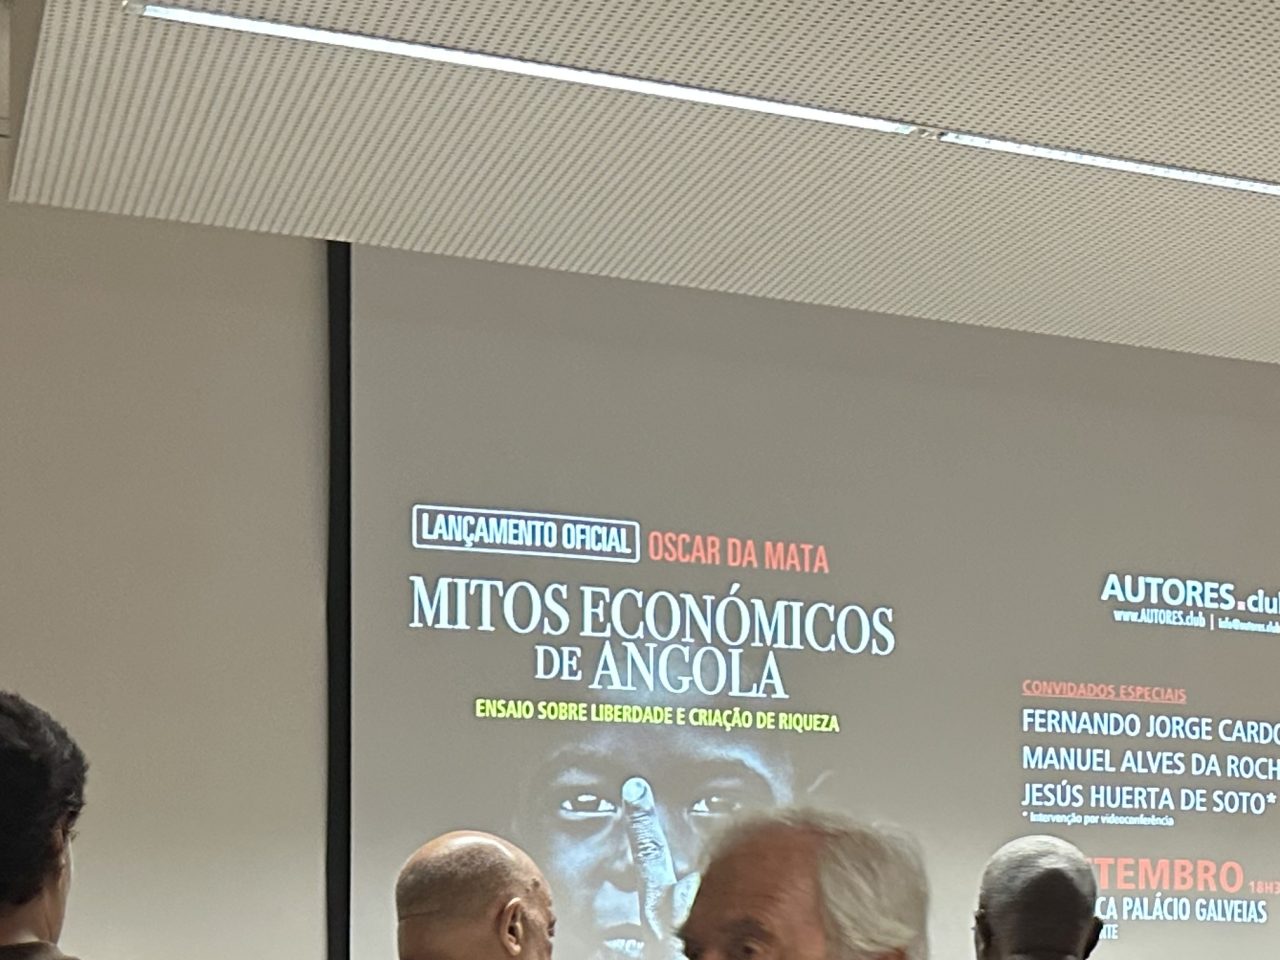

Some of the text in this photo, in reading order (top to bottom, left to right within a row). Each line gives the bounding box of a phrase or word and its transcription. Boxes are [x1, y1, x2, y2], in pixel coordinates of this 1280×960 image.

[422, 513, 632, 553] LANÇAMENTO OFICIAL
[648, 531, 829, 574] OSCAR DA MATA
[408, 575, 896, 656] MITOS ECONÓMICOS
[534, 640, 789, 699] DE ANGOLA
[1022, 679, 1187, 703] CONVIDADOS ESPECIAIS
[475, 699, 840, 733] ENSAIO SOBRE LIBERDADE E CRIAÇÃO DE RIQUEZA
[1022, 708, 1141, 737] FERNANDO
[1146, 715, 1212, 741] JORGE
[1022, 745, 1116, 773] MANUEL
[1120, 750, 1185, 776] ALVES
[1191, 753, 1221, 777] DA
[1021, 780, 1083, 808] JESÚS
[1090, 785, 1174, 811] HUERTA
[1180, 788, 1207, 812] DE
[1084, 814, 1099, 826] por
[1086, 857, 1244, 894] TEMBRO
[1094, 892, 1267, 924] CA PALÁCIO GALVEIAS
